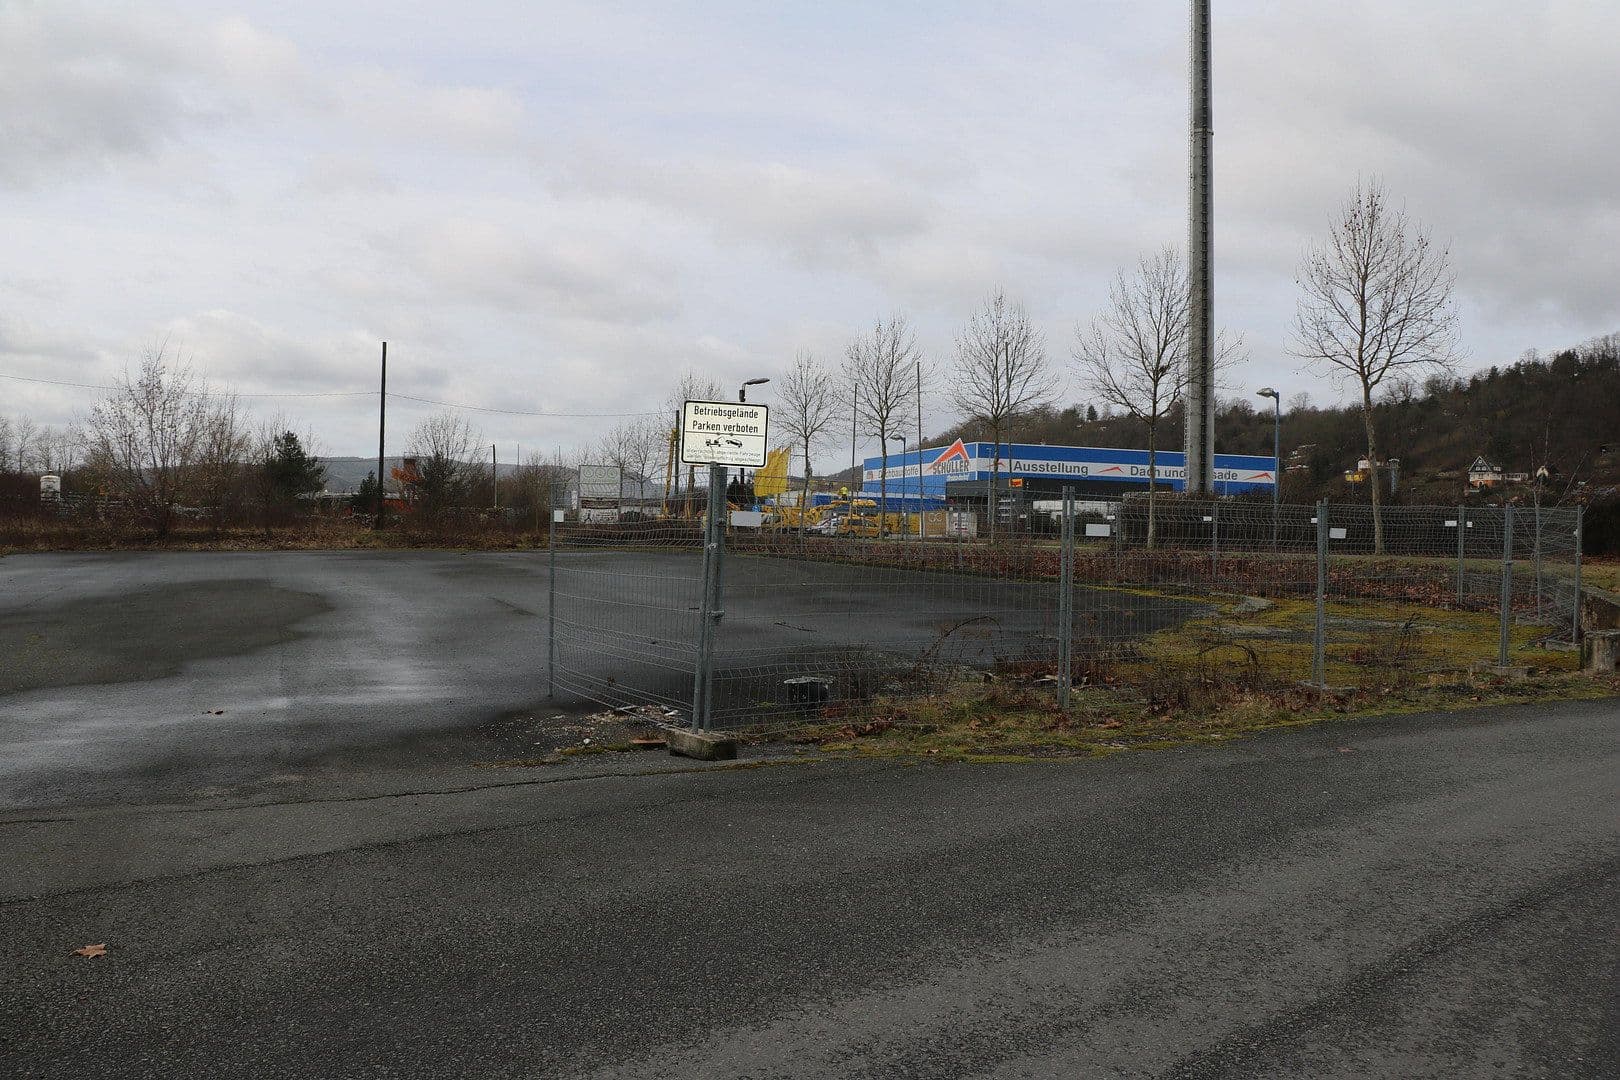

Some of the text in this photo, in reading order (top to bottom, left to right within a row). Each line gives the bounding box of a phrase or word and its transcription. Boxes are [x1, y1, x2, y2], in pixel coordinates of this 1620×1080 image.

[694, 405, 759, 419] Betriebsgelände
[692, 420, 758, 433] Parken verboten
[878, 466, 919, 478] Dchbautoffe
[932, 458, 969, 474] SCHÜLLER
[1013, 460, 1088, 476] Ausstellung
[1213, 470, 1238, 480] sade
